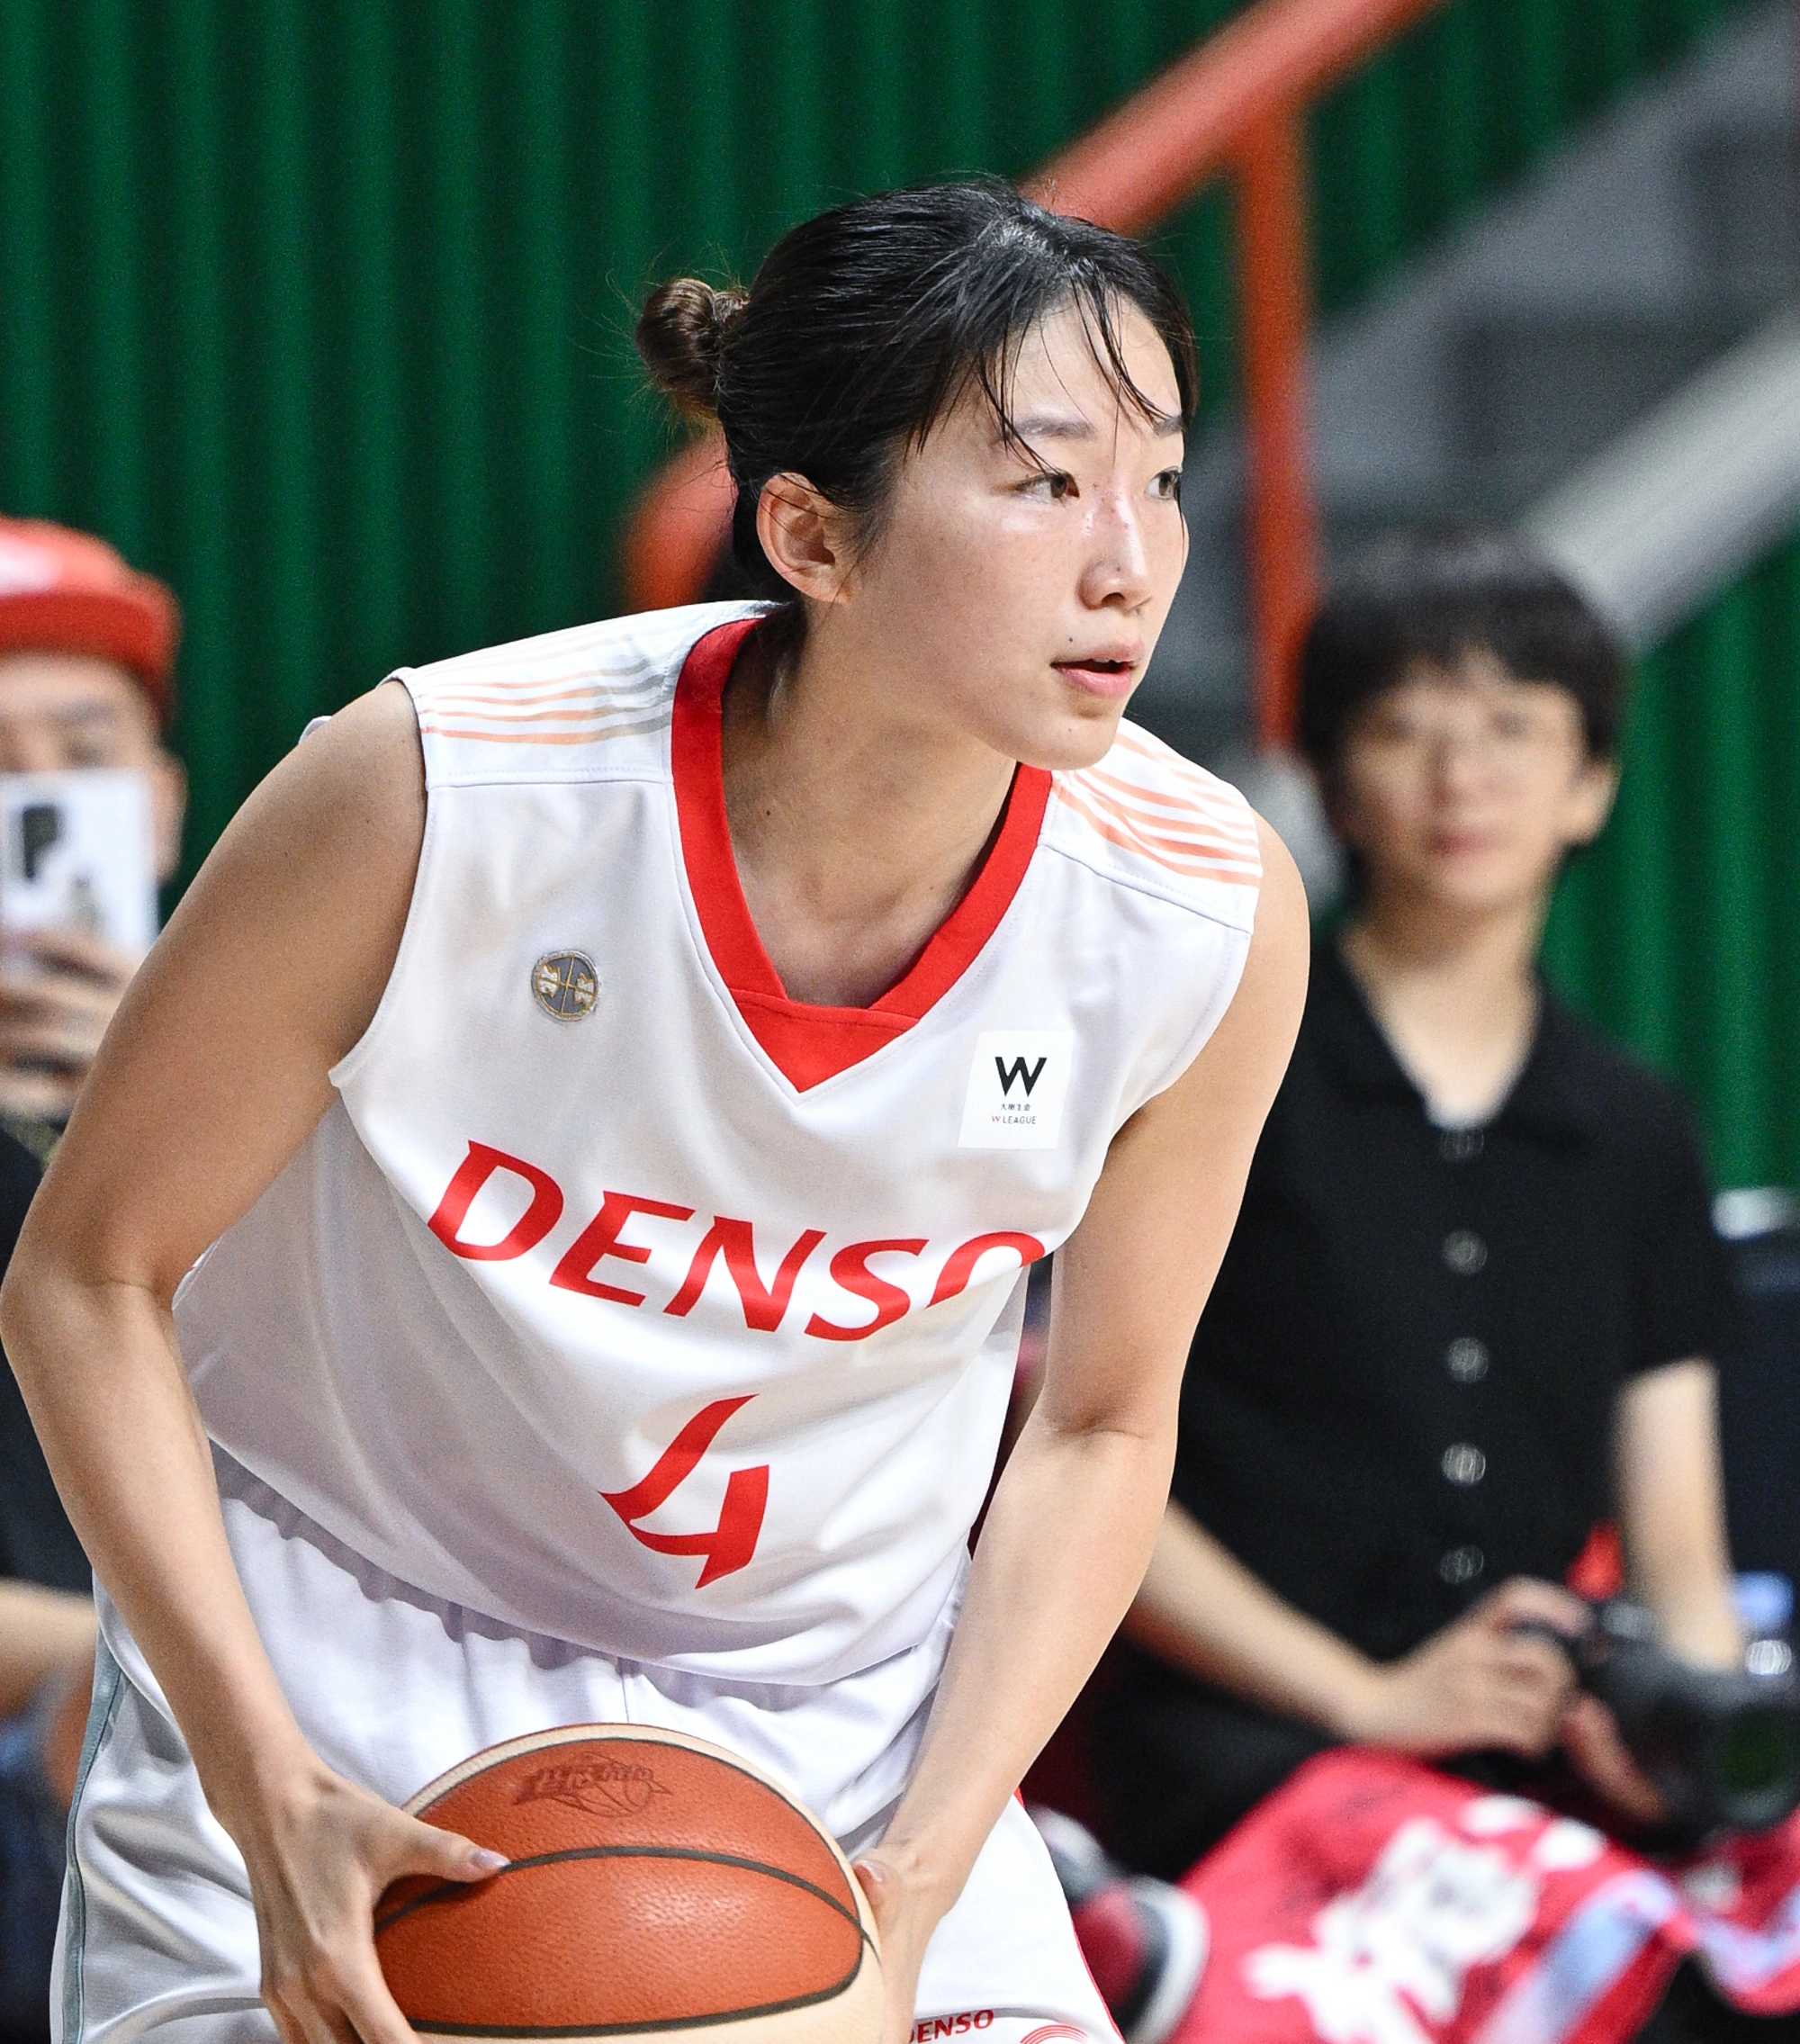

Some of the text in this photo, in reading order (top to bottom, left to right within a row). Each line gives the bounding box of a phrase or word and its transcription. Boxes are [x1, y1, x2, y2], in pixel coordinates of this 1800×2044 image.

[994, 1056, 1048, 1098] W
[1003, 1115, 1037, 1124] LEAGUE
[598, 1394, 770, 1589] 4
